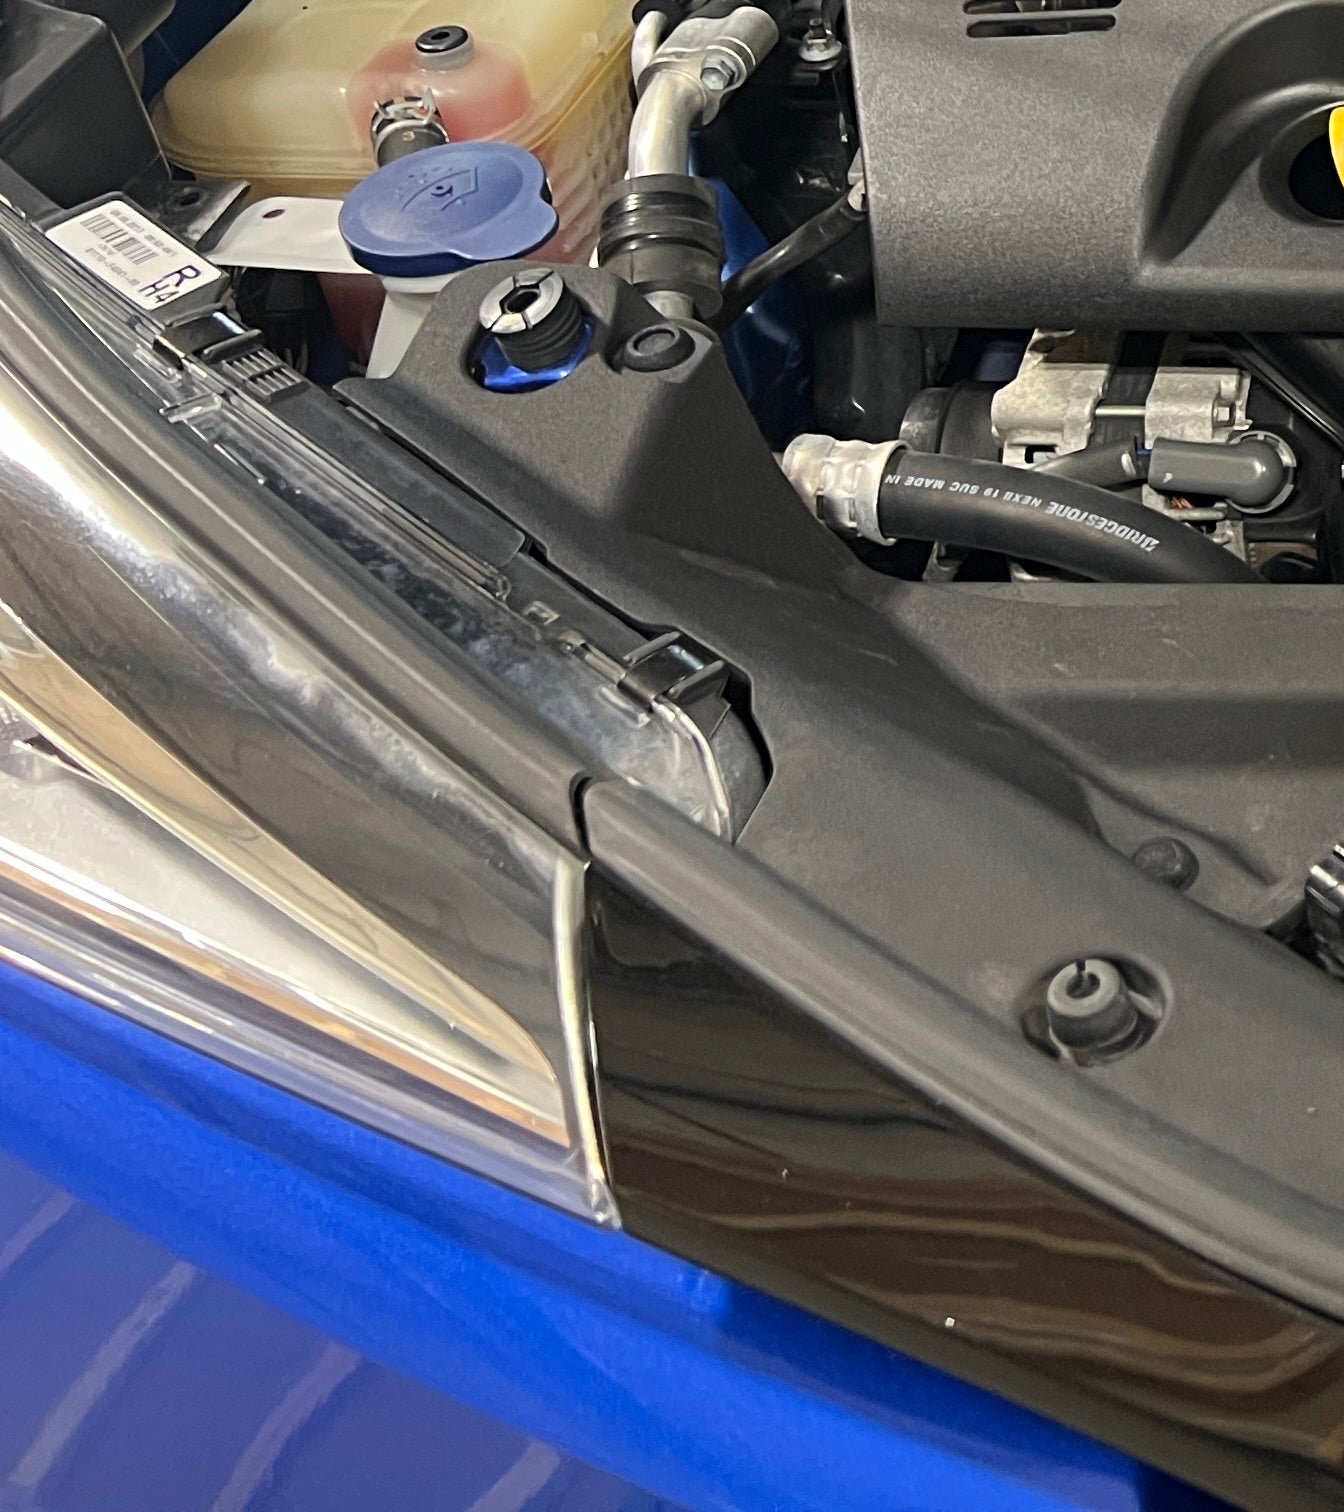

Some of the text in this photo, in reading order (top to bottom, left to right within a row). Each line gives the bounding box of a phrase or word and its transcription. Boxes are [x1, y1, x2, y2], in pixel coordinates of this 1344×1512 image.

[161, 264, 202, 288] R
[138, 278, 180, 304] H4
[884, 474, 901, 485] IN
[904, 475, 946, 490] MADE
[1043, 501, 1160, 552] BRIDGESTONE
